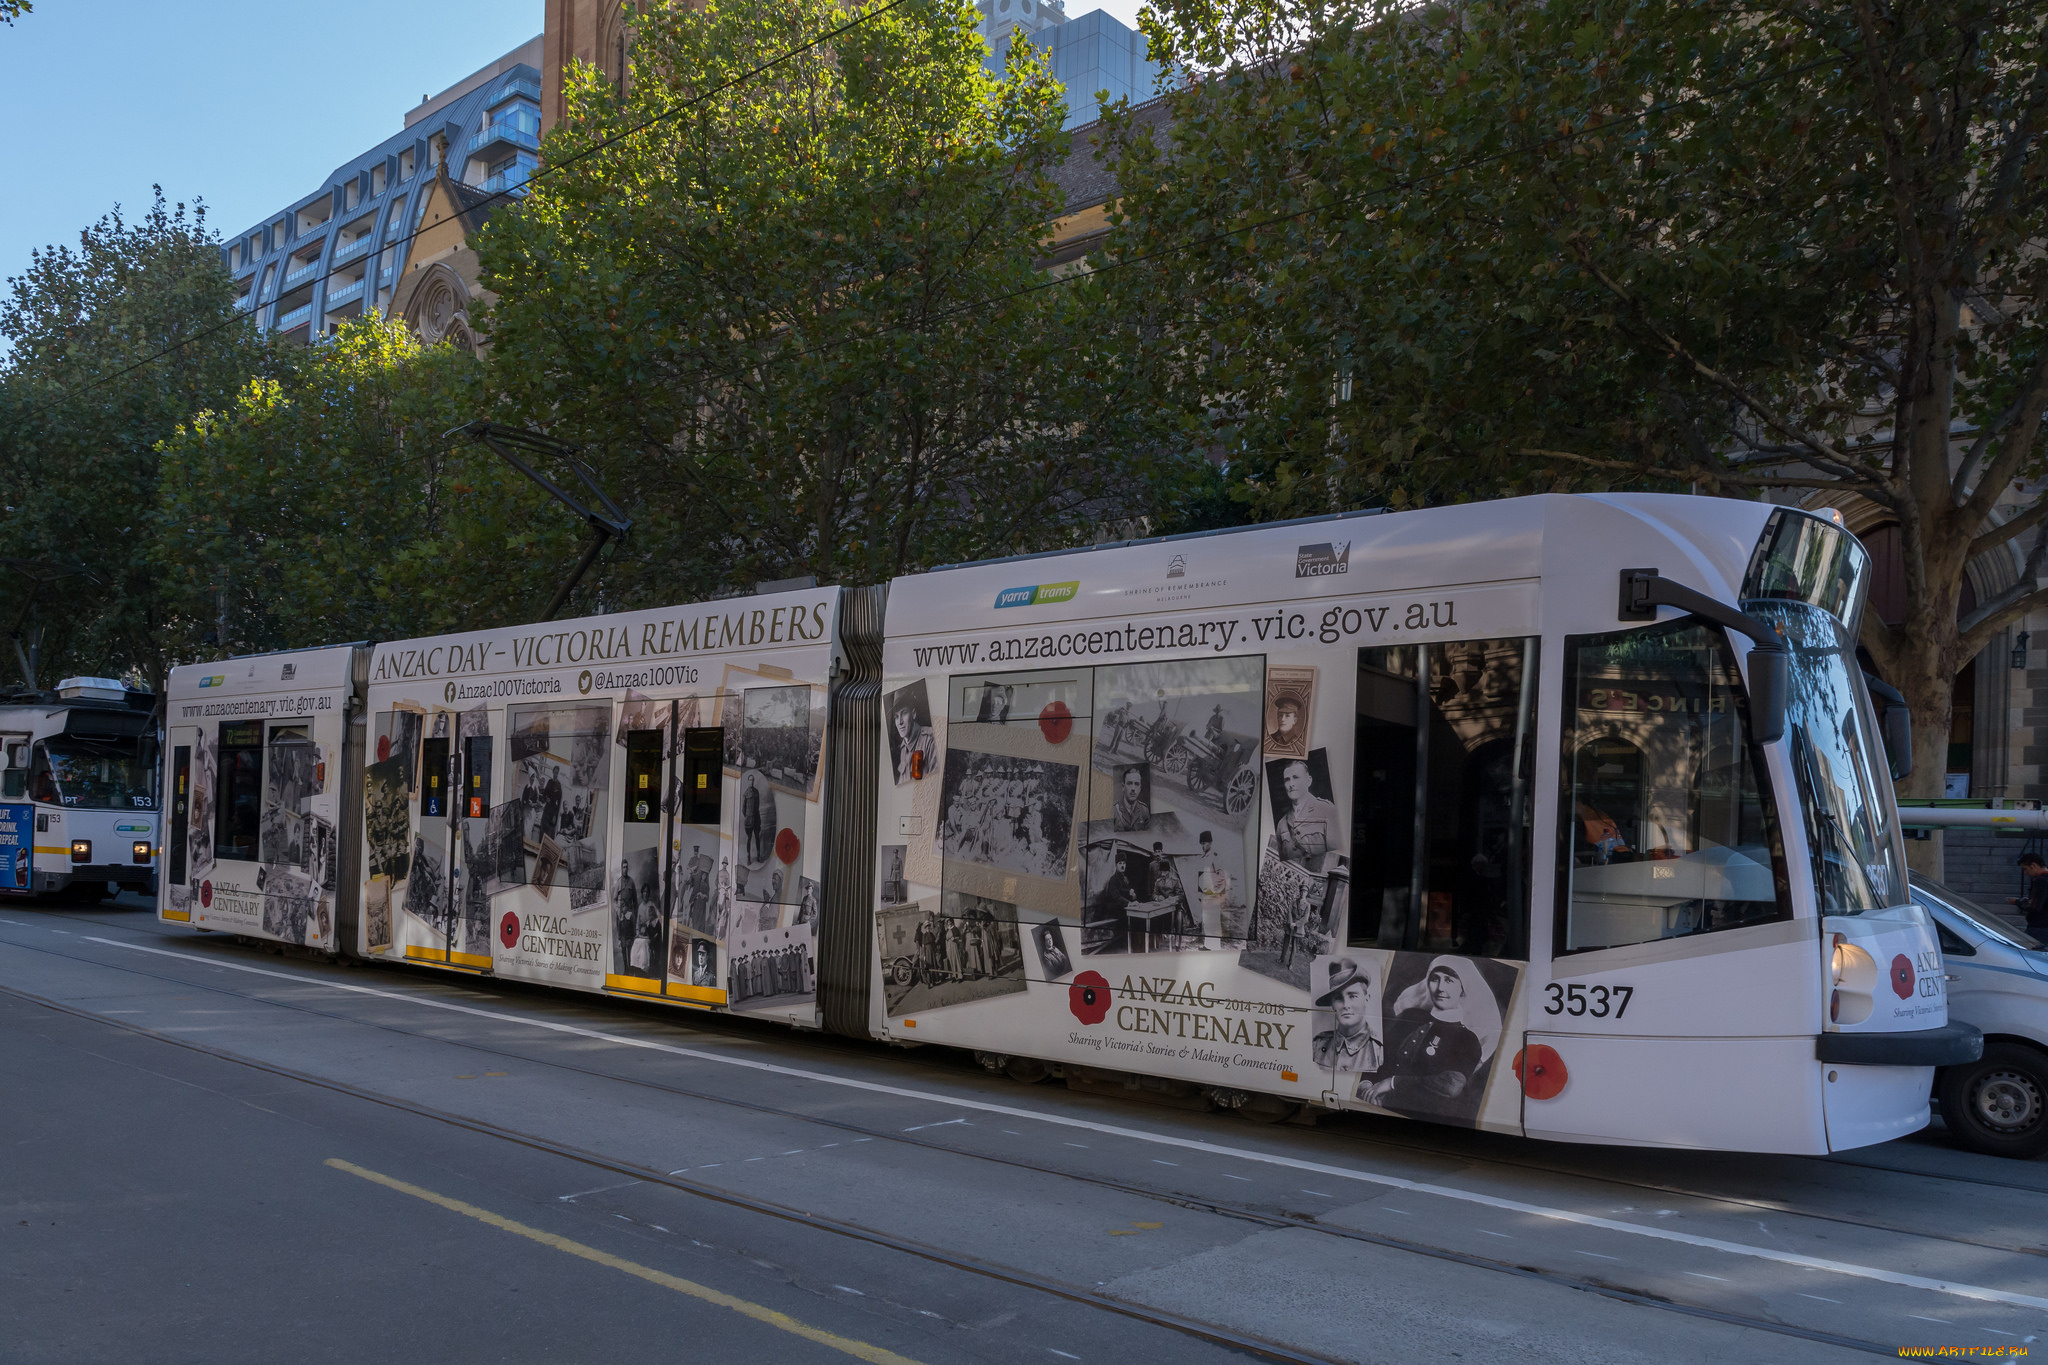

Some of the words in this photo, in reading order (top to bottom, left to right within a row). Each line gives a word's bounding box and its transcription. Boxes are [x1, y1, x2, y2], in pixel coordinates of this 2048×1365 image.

[1298, 562, 1347, 576] Victoria
[1001, 591, 1030, 606] yarra
[1039, 586, 1072, 599] trams
[1124, 587, 1152, 596] SHRINE
[1167, 580, 1227, 591] REMEMBRANCE
[374, 646, 443, 680] ANZAC
[446, 641, 493, 674] DAY
[513, 626, 631, 668] VICTORIA
[640, 602, 827, 656] REMEMBERS
[913, 600, 1457, 668] www.anzaccentenary.vic.gov.au
[457, 677, 561, 700] Anzac100Victoria
[594, 665, 698, 690] @Anzac100Vic
[182, 696, 331, 718] www.anzaccentenary.vic.gov.au
[132, 796, 152, 807] 153
[49, 814, 61, 823] 153
[213, 881, 240, 897] ANZAC
[213, 897, 260, 916] CENTENARY
[523, 914, 567, 935] ANZAC
[521, 934, 602, 962] CENTENARY
[1118, 974, 1215, 1009] ANZAC
[1543, 982, 1634, 1019] 3537
[1117, 1005, 1295, 1051] CENTENARY
[1067, 1031, 1102, 1051] Sharing
[1104, 1036, 1144, 1054] Victoria's
[1146, 1042, 1176, 1058] Stories
[1178, 1047, 1190, 1059] &
[1191, 1049, 1229, 1069] Making
[1232, 1053, 1293, 1073] Connections
